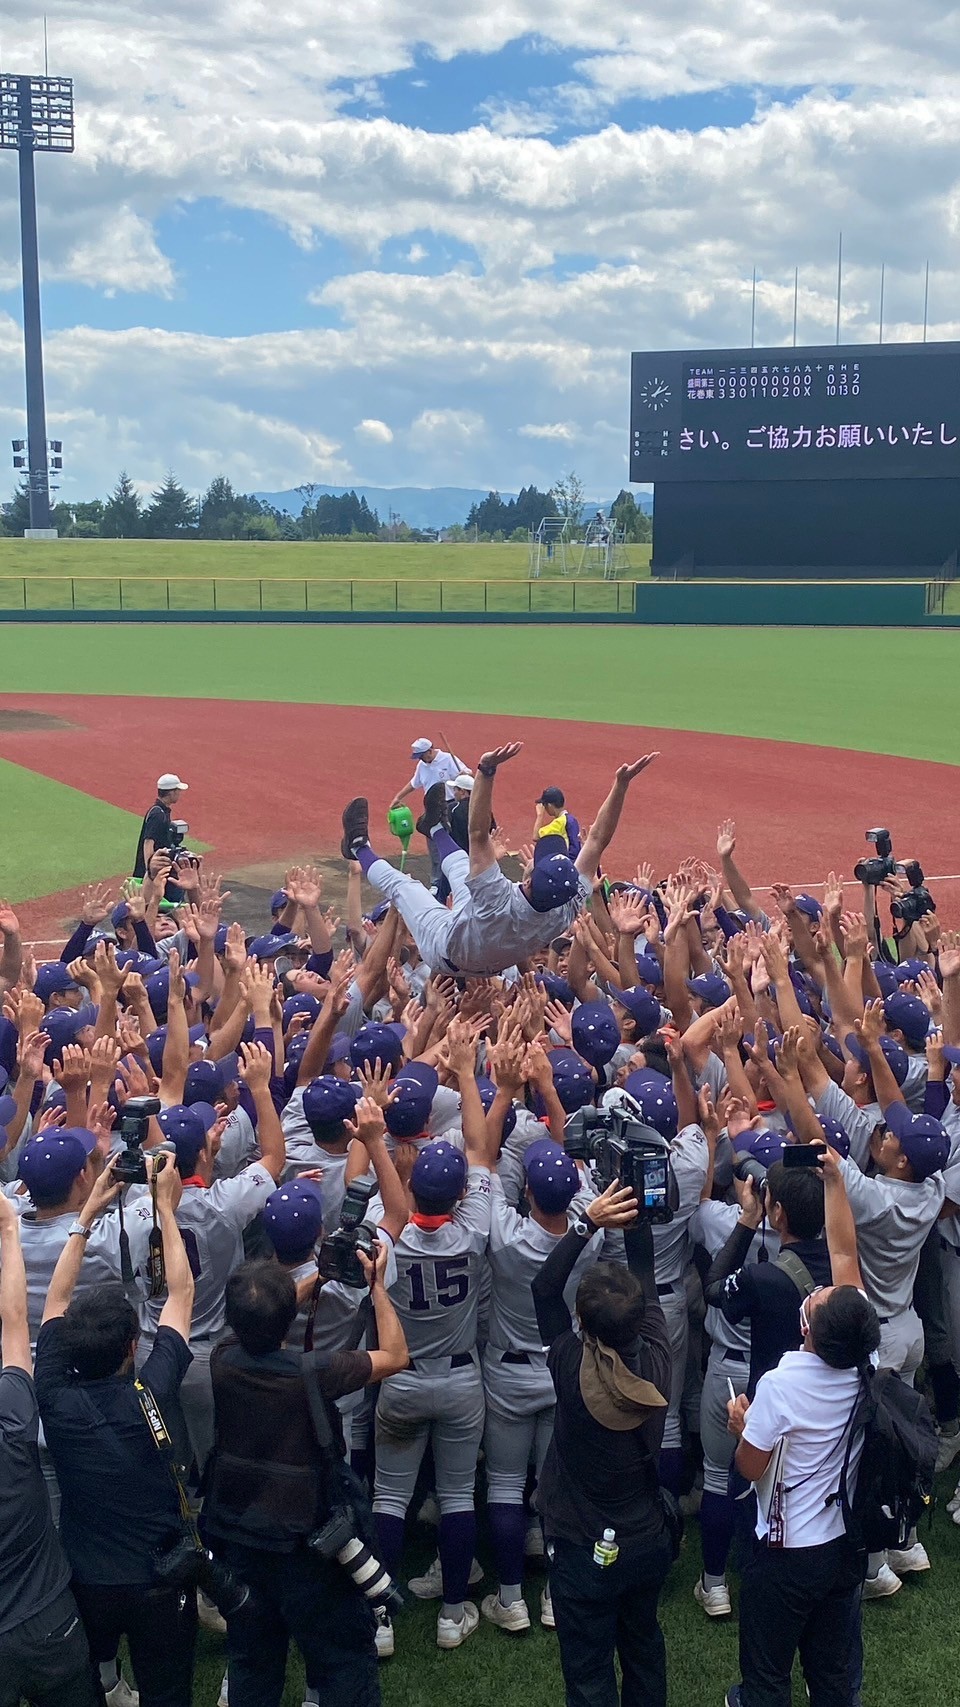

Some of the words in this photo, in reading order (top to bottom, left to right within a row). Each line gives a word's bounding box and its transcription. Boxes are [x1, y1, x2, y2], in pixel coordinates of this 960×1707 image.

[688, 389, 714, 399] 花巻東
[826, 386, 835, 396] 10
[839, 385, 848, 395] 13
[406, 1257, 469, 1310] 15
[148, 1409, 162, 1431] NPS
